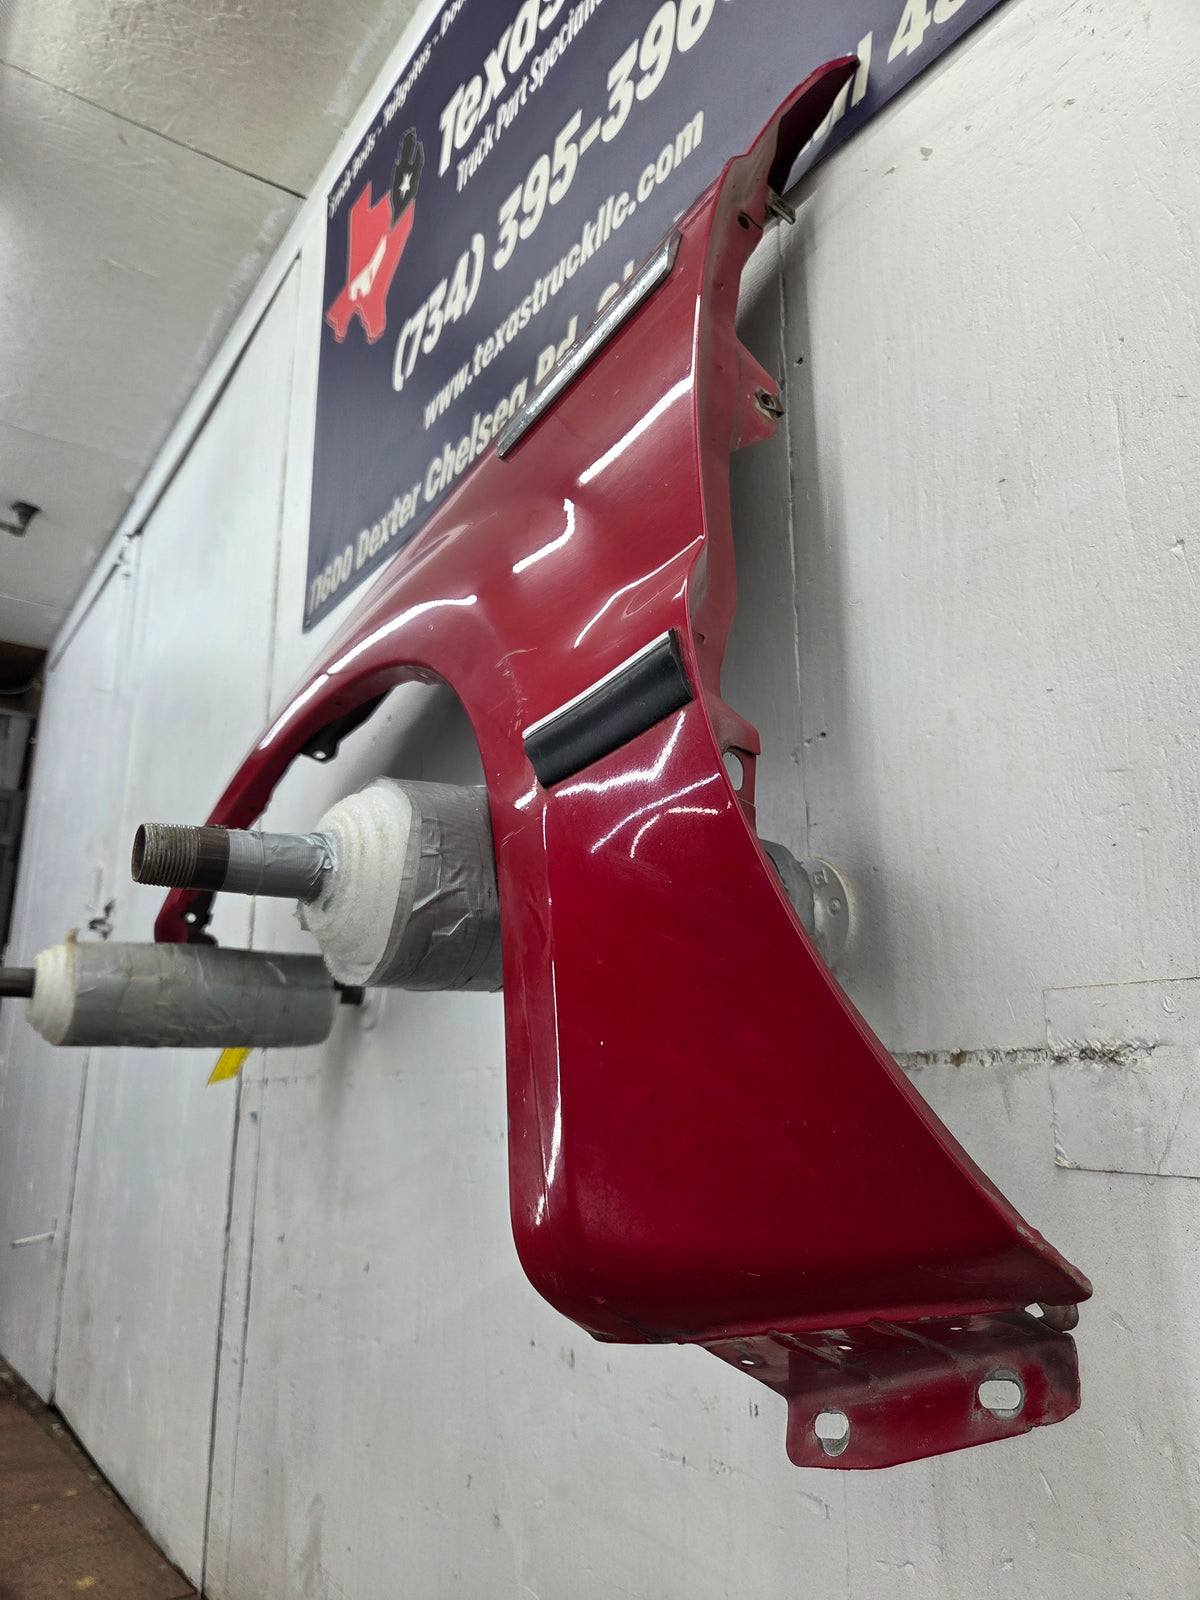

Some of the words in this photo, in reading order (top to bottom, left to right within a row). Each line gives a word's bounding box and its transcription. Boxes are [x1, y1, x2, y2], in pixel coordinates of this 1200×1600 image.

[392, 233, 485, 391] (734)
[493, 0, 717, 271] 395-396
[456, 124, 495, 193] Truck
[495, 75, 529, 141] Part
[424, 110, 704, 430] www.texastruckllc.com
[356, 481, 422, 571] Dexter
